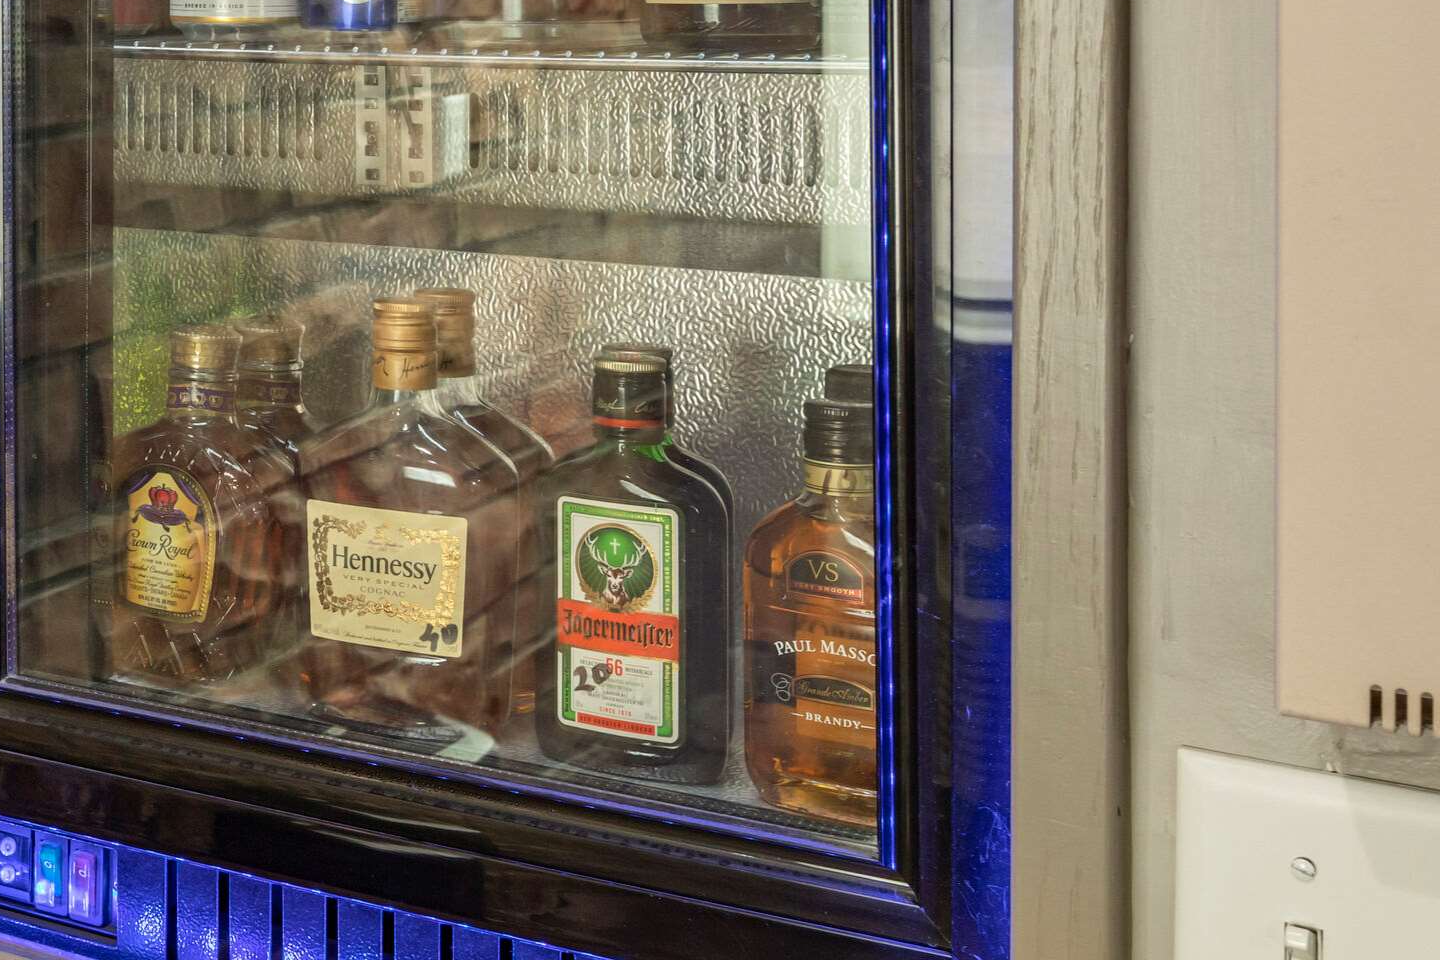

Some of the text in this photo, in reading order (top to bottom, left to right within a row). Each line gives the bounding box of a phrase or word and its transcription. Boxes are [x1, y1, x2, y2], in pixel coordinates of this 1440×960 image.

[128, 528, 199, 560] Crown Royal
[332, 544, 438, 585] Hennessy
[808, 559, 840, 582] VS
[343, 574, 425, 590] VERY SPECIAL
[360, 585, 406, 598] COGNAC
[774, 640, 816, 656] PAUL
[805, 712, 861, 730] BRANDY
